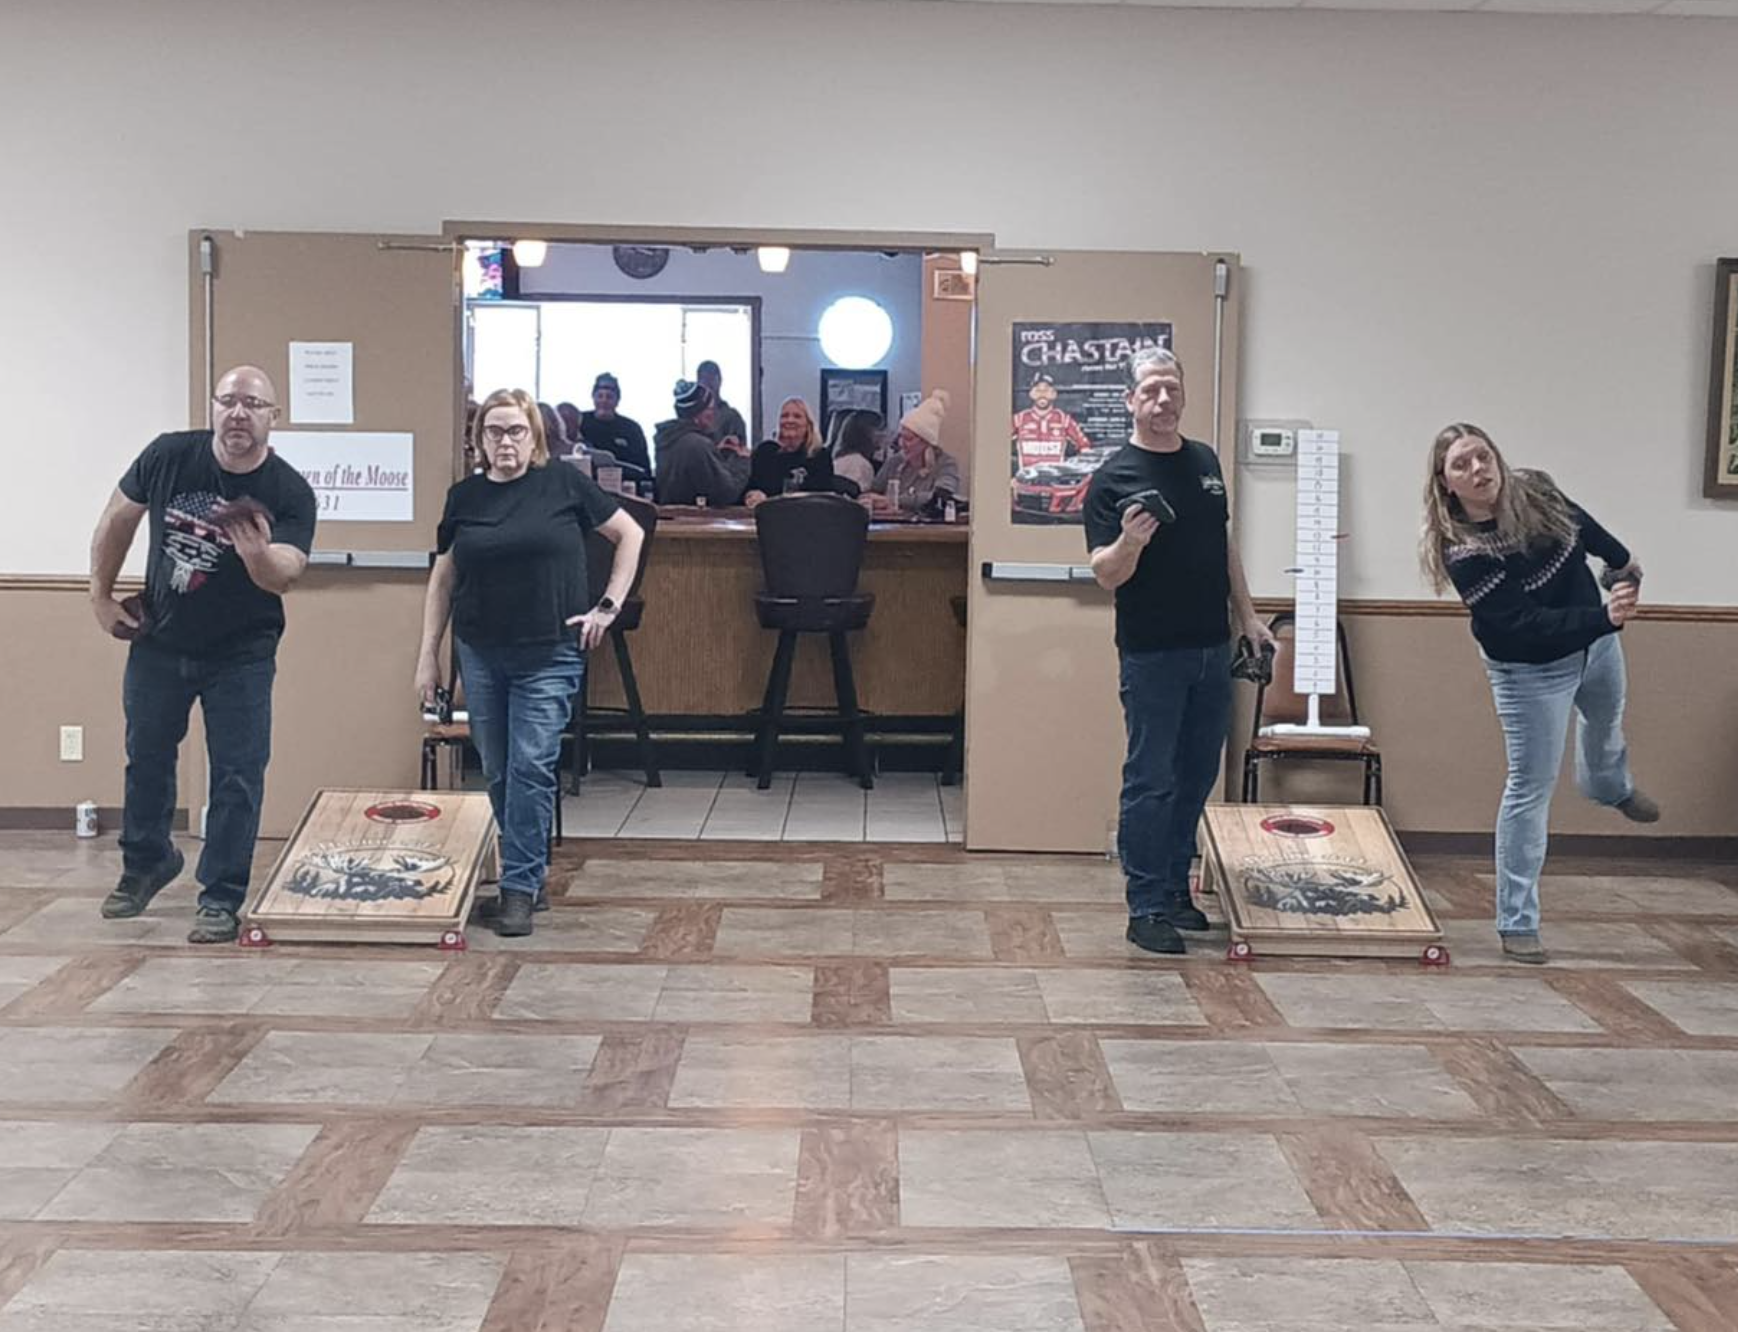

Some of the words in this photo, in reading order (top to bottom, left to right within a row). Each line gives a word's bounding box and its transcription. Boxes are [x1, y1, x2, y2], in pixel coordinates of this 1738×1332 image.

[324, 464, 340, 488] of
[341, 464, 363, 486] the
[364, 464, 409, 487] Moose
